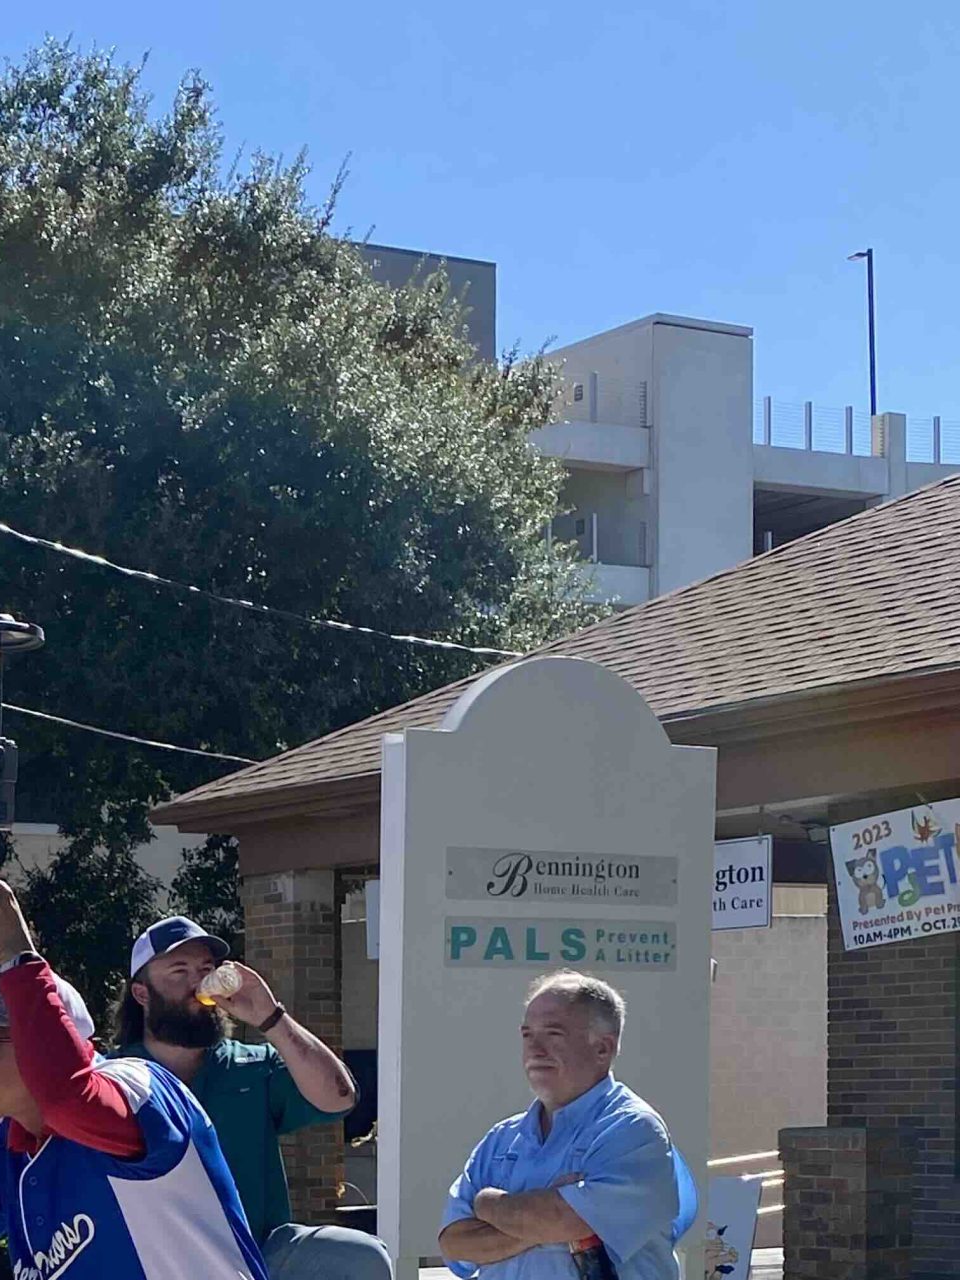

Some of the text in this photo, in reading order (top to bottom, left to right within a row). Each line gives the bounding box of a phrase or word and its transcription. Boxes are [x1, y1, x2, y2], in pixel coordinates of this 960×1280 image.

[852, 821, 892, 850] 2023
[486, 852, 640, 898] Bennington
[715, 865, 765, 892] gton
[534, 882, 640, 898] Home Health Care
[731, 896, 763, 911] Care
[852, 911, 905, 931] Presented
[906, 910, 922, 921] By
[925, 904, 945, 917] Pet
[450, 926, 587, 962] PALS
[596, 929, 669, 945] Prevent
[853, 925, 912, 946] 10AM-4PM
[595, 948, 671, 963] A Litter
